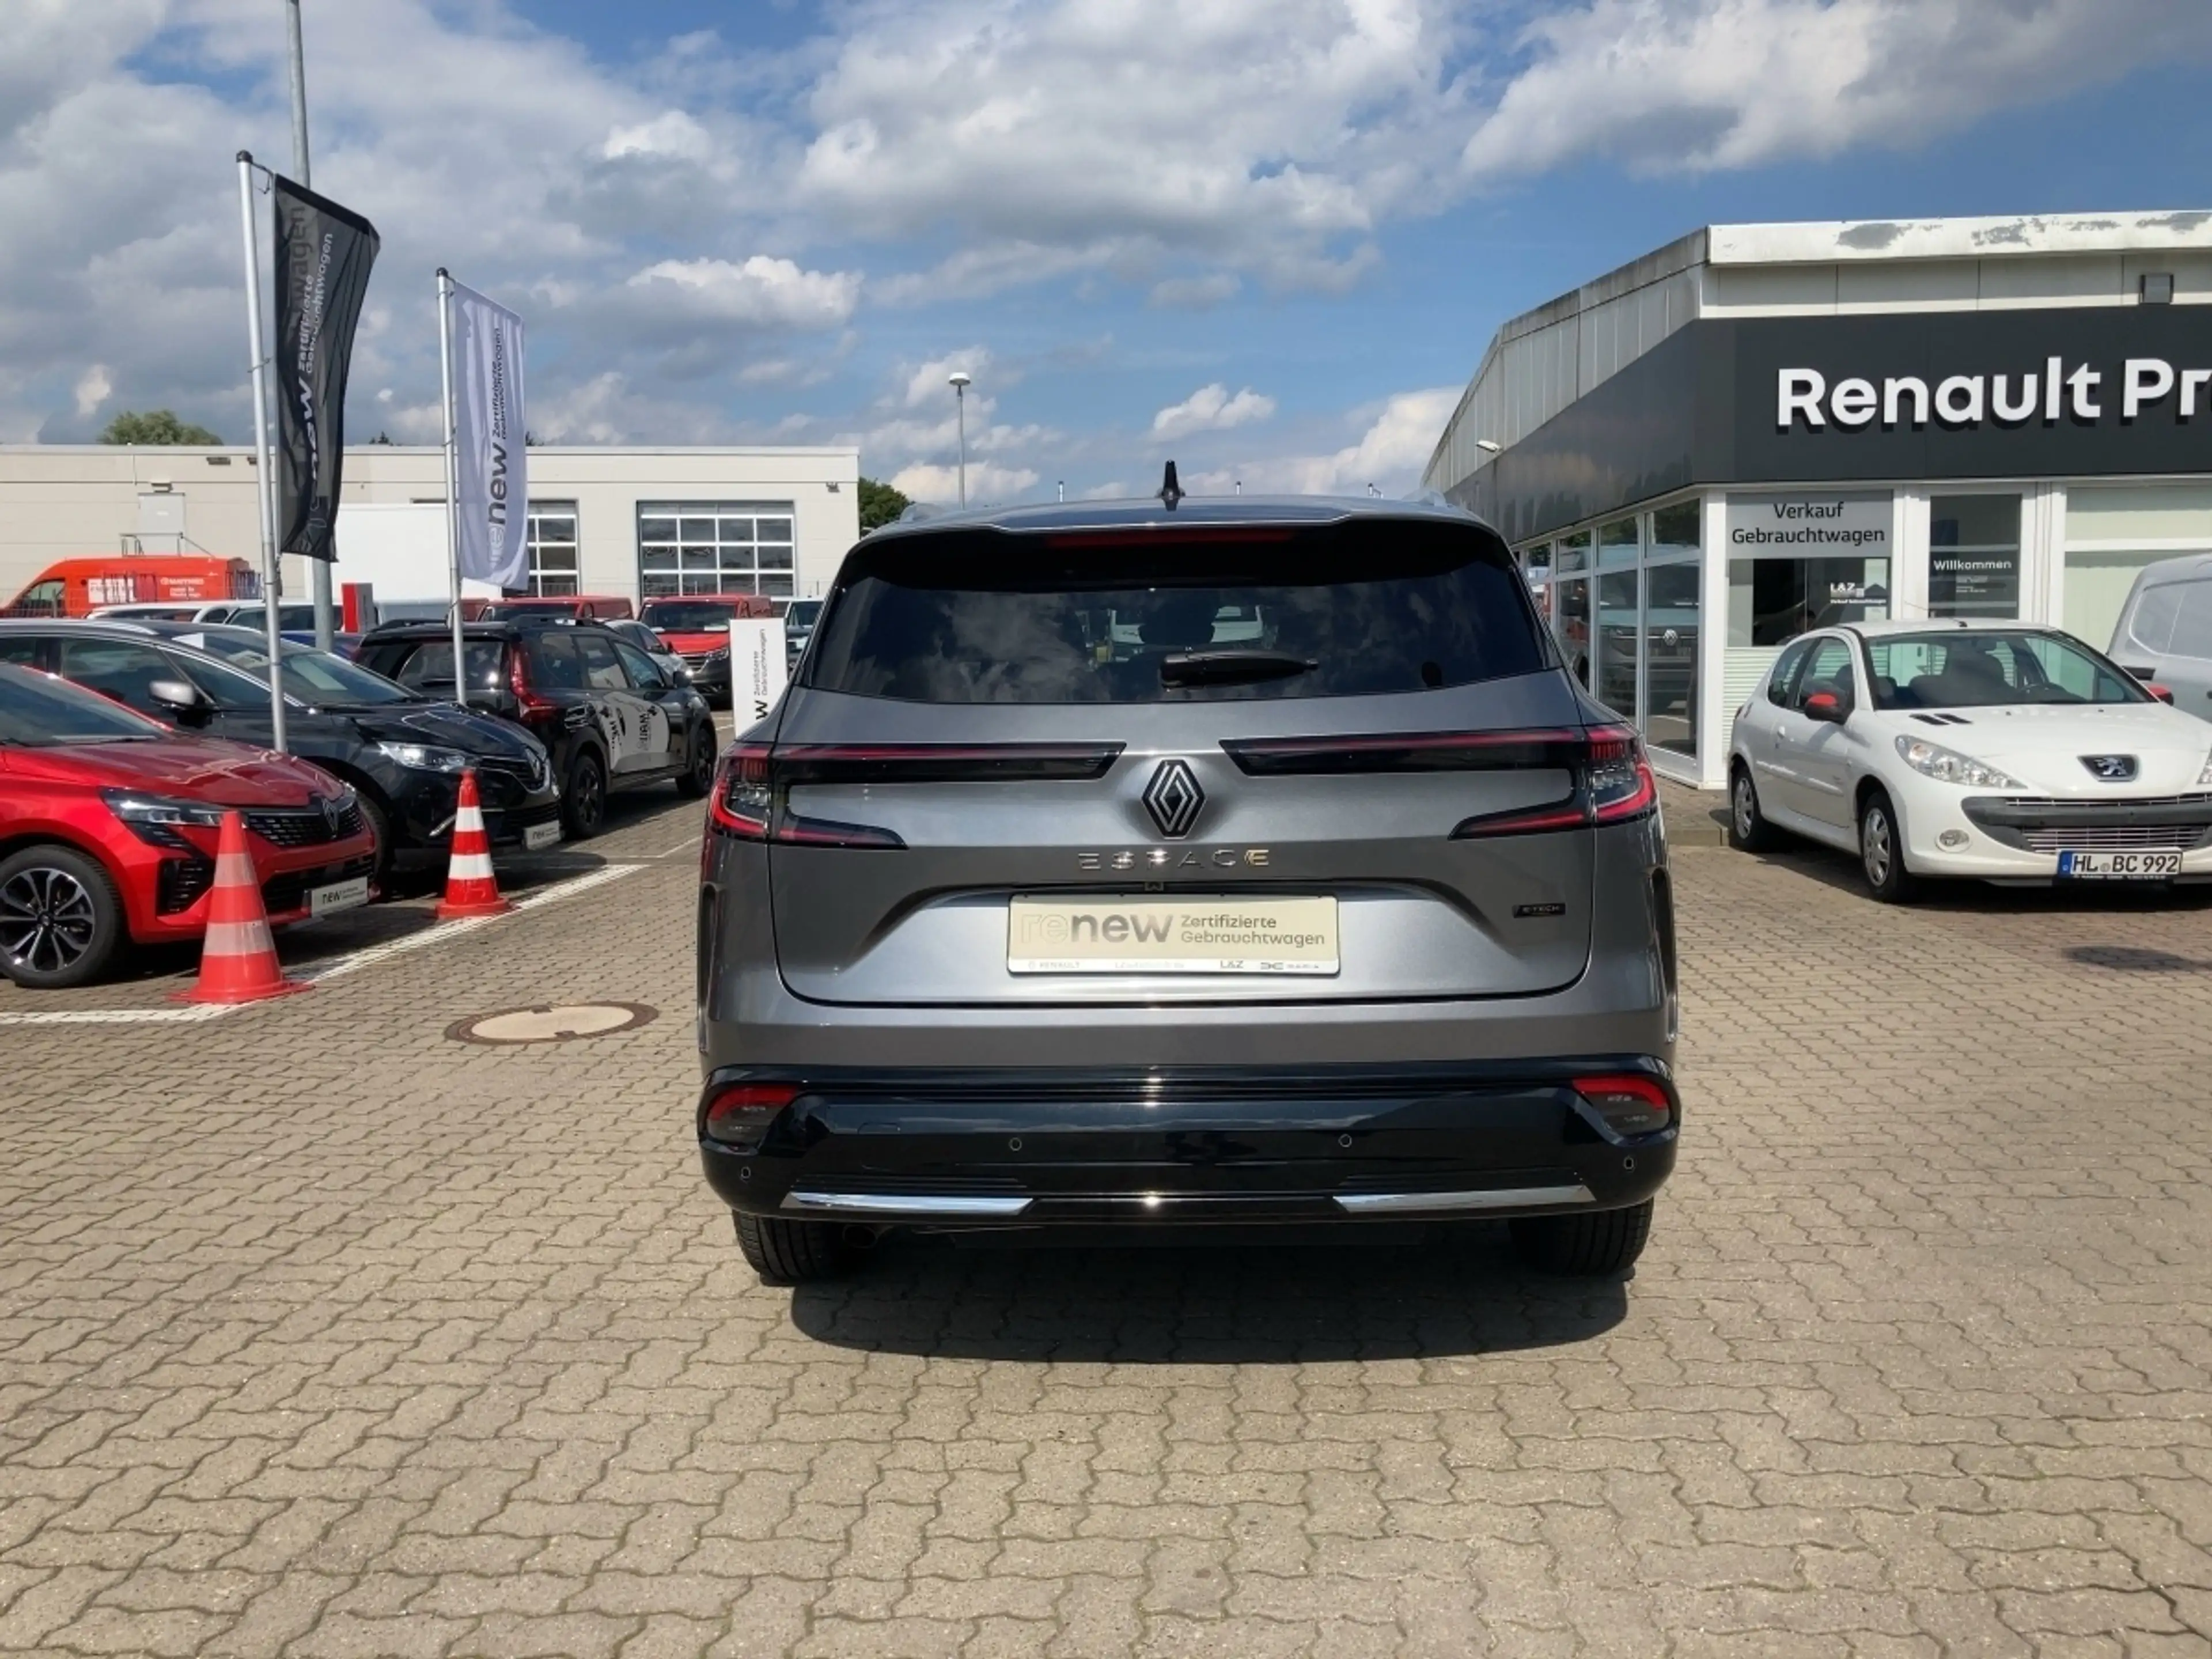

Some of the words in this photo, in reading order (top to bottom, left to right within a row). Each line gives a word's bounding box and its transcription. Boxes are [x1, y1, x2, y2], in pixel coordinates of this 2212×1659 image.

[1777, 356, 2101, 426] Renault
[1773, 501, 1845, 519] Verkauf
[1732, 528, 1885, 547] Gebrauchtwagen
[1933, 559, 2012, 570] Willkommen
[1078, 849, 1270, 870] ESPACE
[2074, 855, 2099, 872] HL
[2112, 855, 2138, 872] BC
[2143, 855, 2179, 873] 992
[1021, 914, 1174, 944] renew
[1181, 914, 1277, 929] Zertifizierte
[1181, 930, 1325, 948] Gebrauchtwagen
